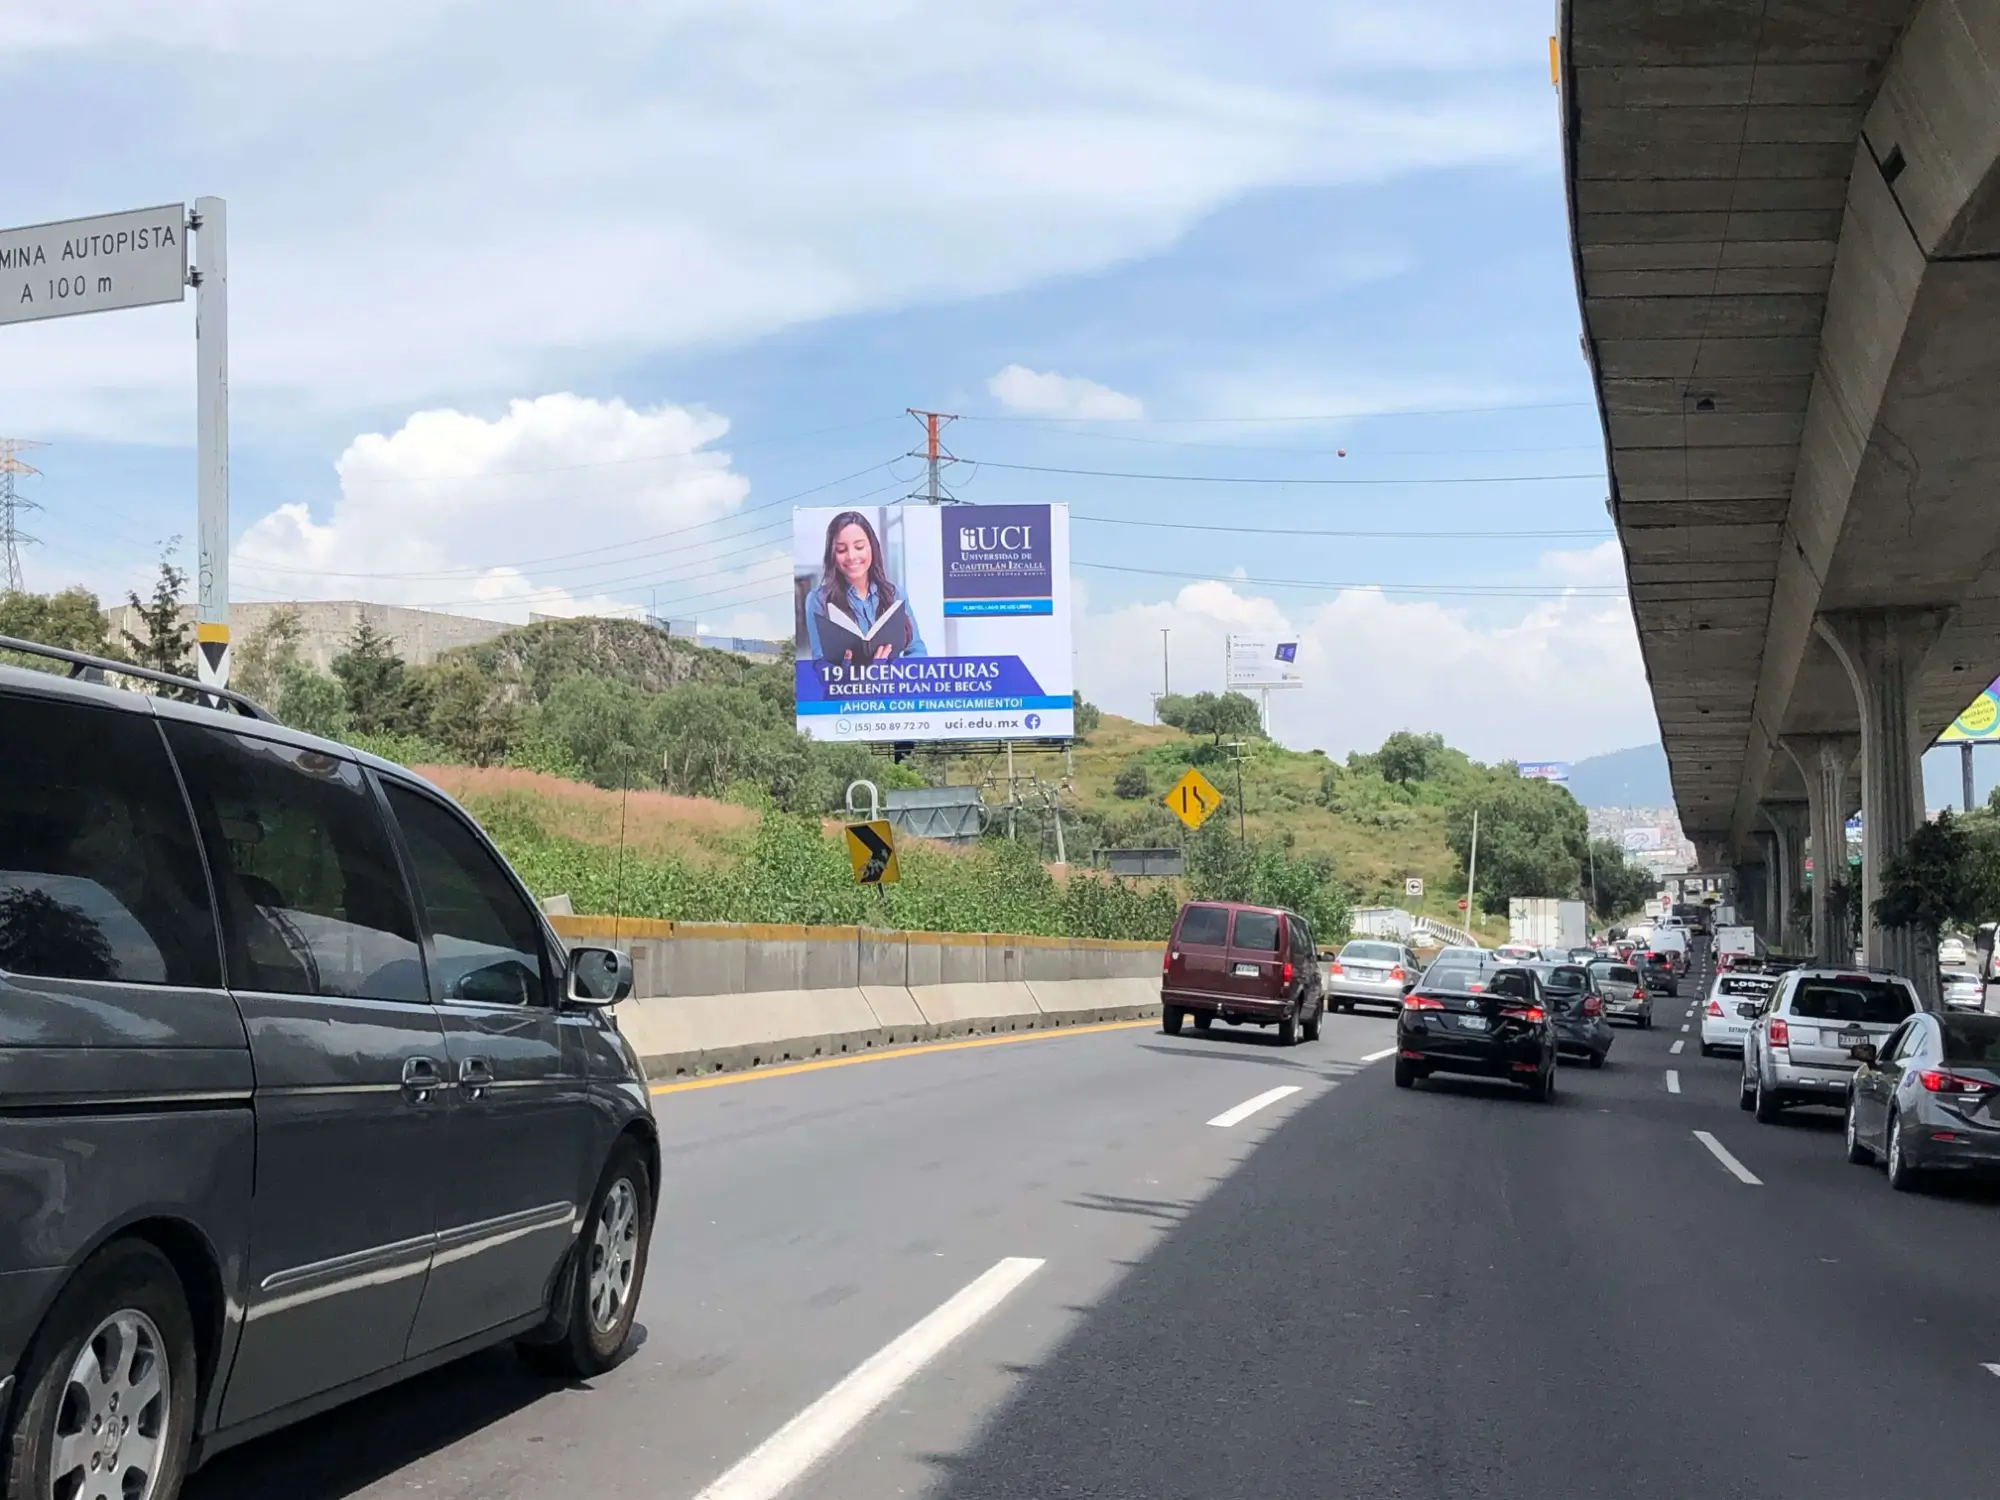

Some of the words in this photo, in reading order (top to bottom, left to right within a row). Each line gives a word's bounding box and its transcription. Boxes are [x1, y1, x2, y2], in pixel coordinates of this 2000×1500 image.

[62, 225, 176, 261] AUTOPISTA
[20, 284, 33, 304] A
[49, 275, 85, 299] 100
[98, 276, 112, 293] m
[822, 665, 843, 682] 19
[850, 662, 999, 681] LICENCIATURAS
[829, 683, 895, 695] EXCELENTE
[899, 682, 930, 693] PLAN
[935, 682, 951, 692] DE
[955, 680, 992, 692] BECAS
[840, 700, 886, 713] ¡AHORA
[889, 699, 914, 710] CON
[919, 697, 1023, 710] FINANCIAMIENTO!
[945, 717, 1019, 729] uci.edu.mx
